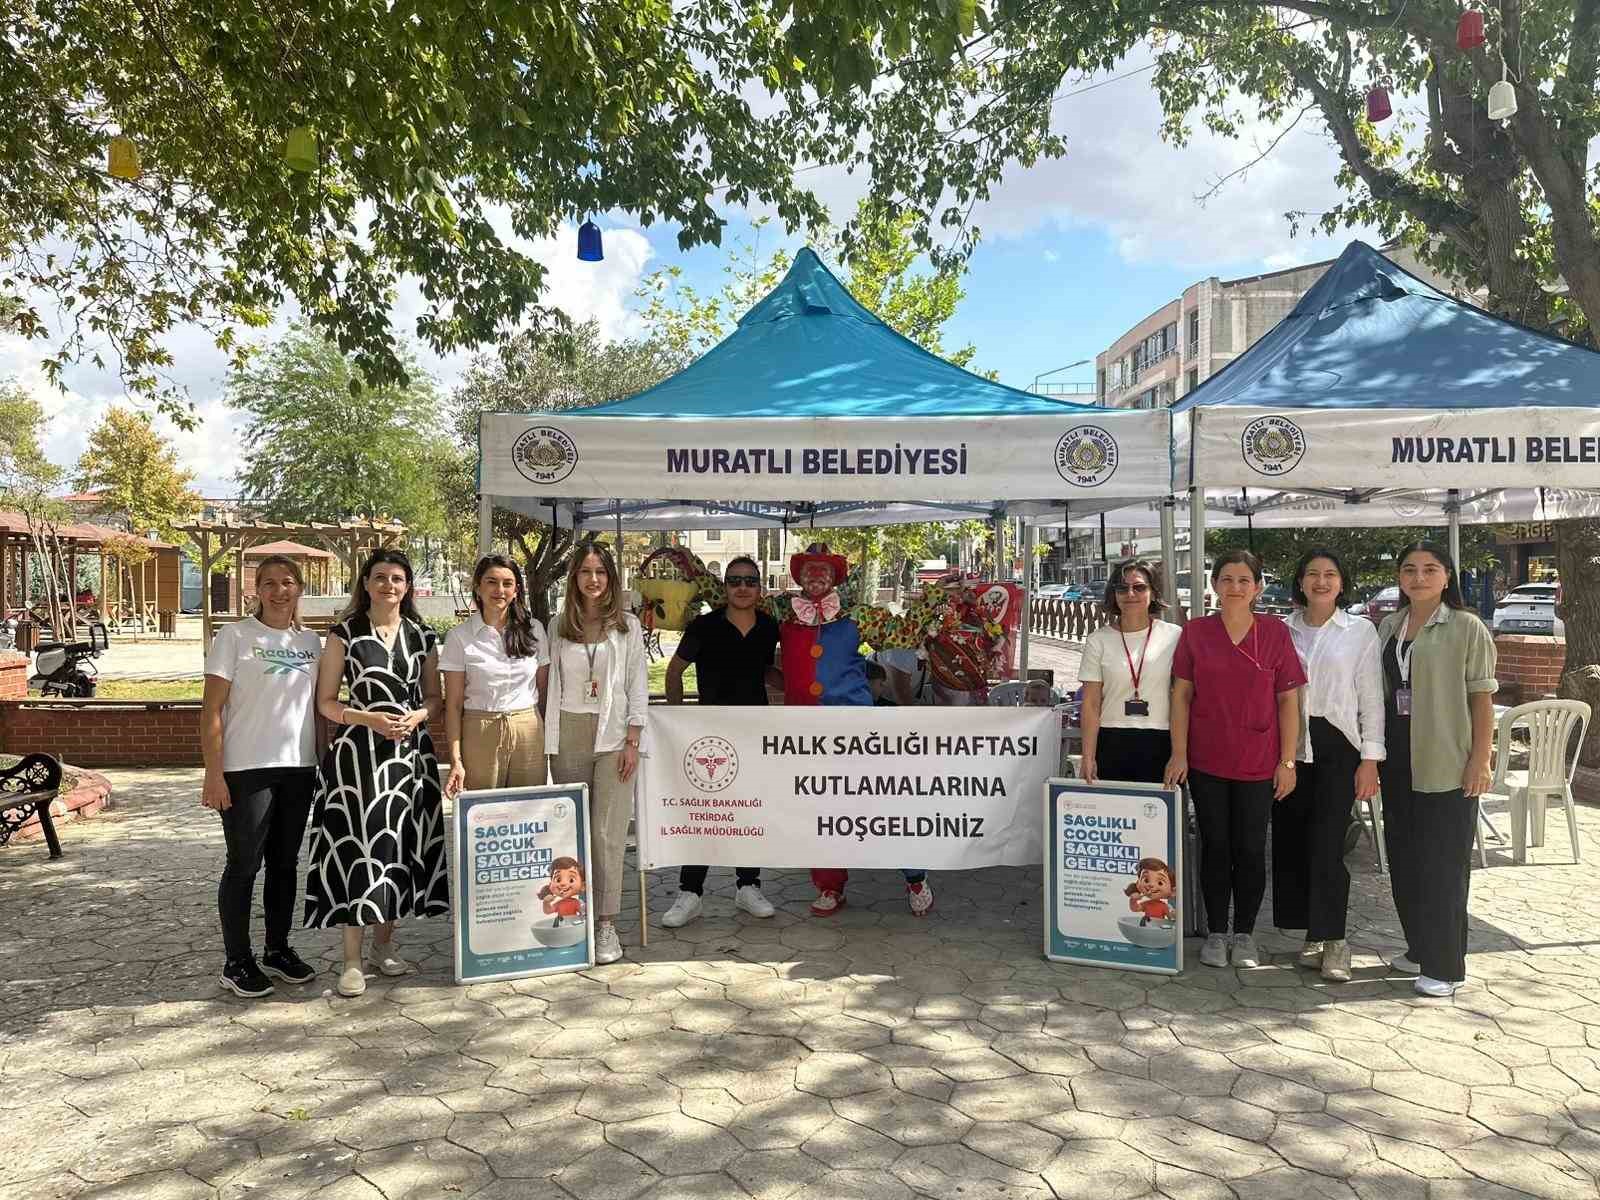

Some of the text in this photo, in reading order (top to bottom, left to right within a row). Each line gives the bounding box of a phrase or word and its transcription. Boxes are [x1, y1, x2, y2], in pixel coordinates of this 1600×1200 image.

[667, 442, 967, 475] MURATLI BELEDİYESİ
[1391, 437, 1600, 463] MURATLI BELE
[536, 471, 555, 480] 1941
[1264, 463, 1283, 471] 1941
[1077, 475, 1097, 484] 1941
[252, 646, 316, 660] Reebok
[762, 731, 1038, 757] HALK SAĞLIĞI HAFTASI
[794, 775, 1007, 797] KUTLAMALARINA
[661, 798, 678, 807] T.C.
[712, 797, 762, 808] BAKANLIĞI
[689, 810, 735, 822] TEKİRDAĞ
[816, 811, 985, 842] HOŞGELDİNİZ
[476, 864, 552, 884] GELECEK
[1064, 856, 1139, 875] GELECEK
